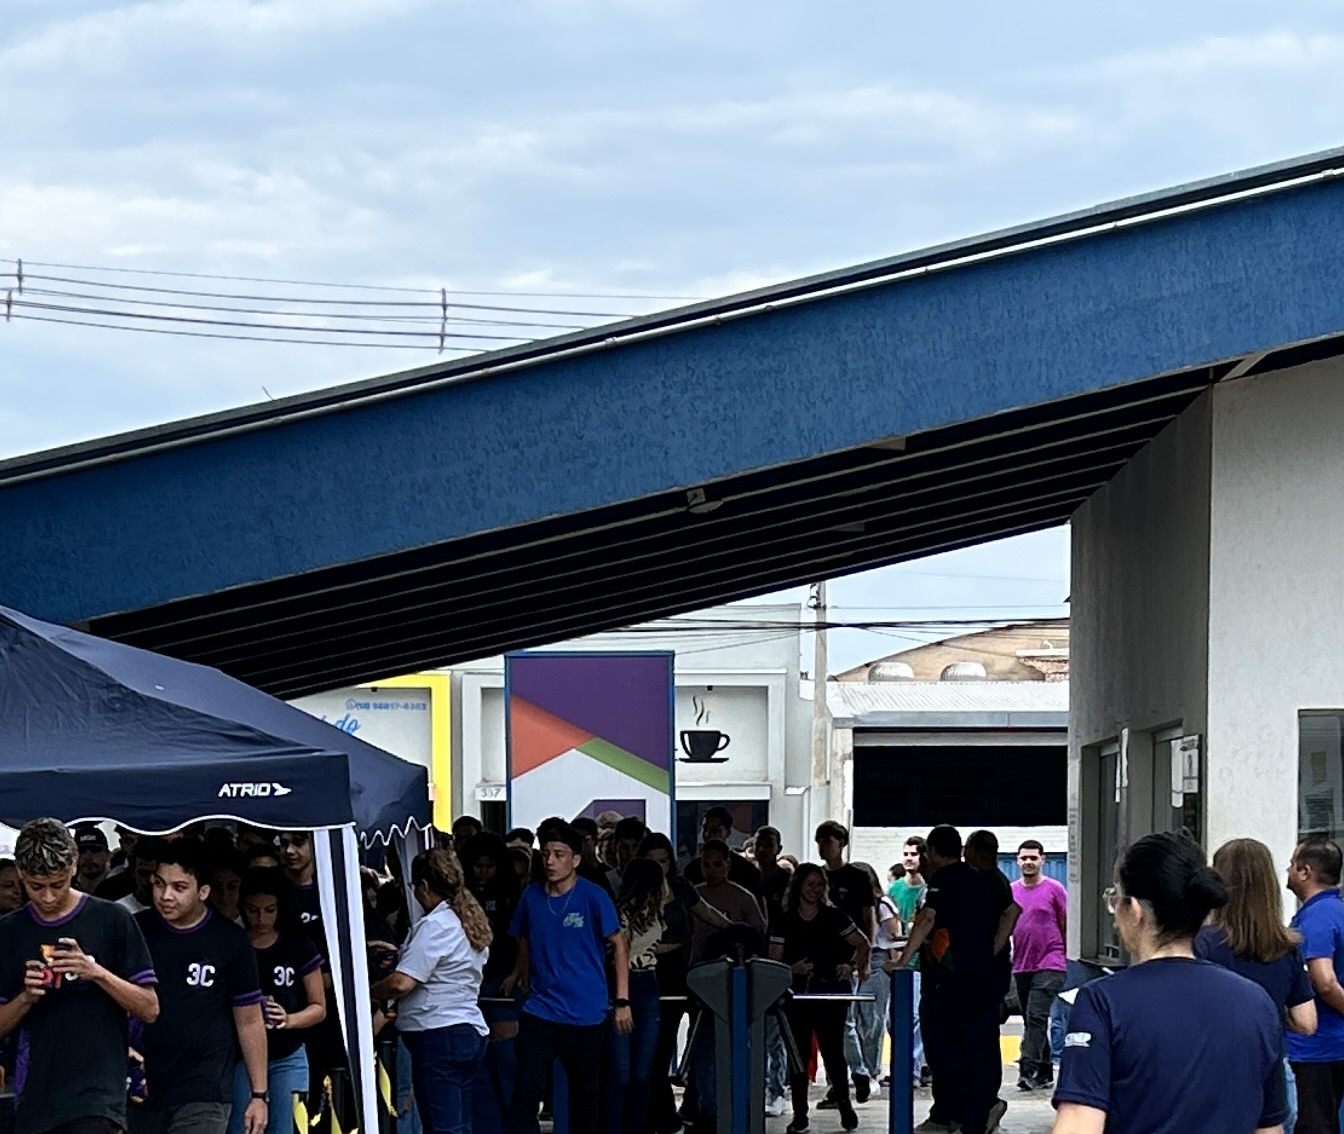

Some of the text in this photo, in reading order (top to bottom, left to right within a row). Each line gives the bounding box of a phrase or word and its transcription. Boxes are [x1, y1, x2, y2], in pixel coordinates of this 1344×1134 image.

[218, 783, 271, 797] ATRIO
[186, 962, 215, 987] 3C
[273, 965, 295, 987] 3C
